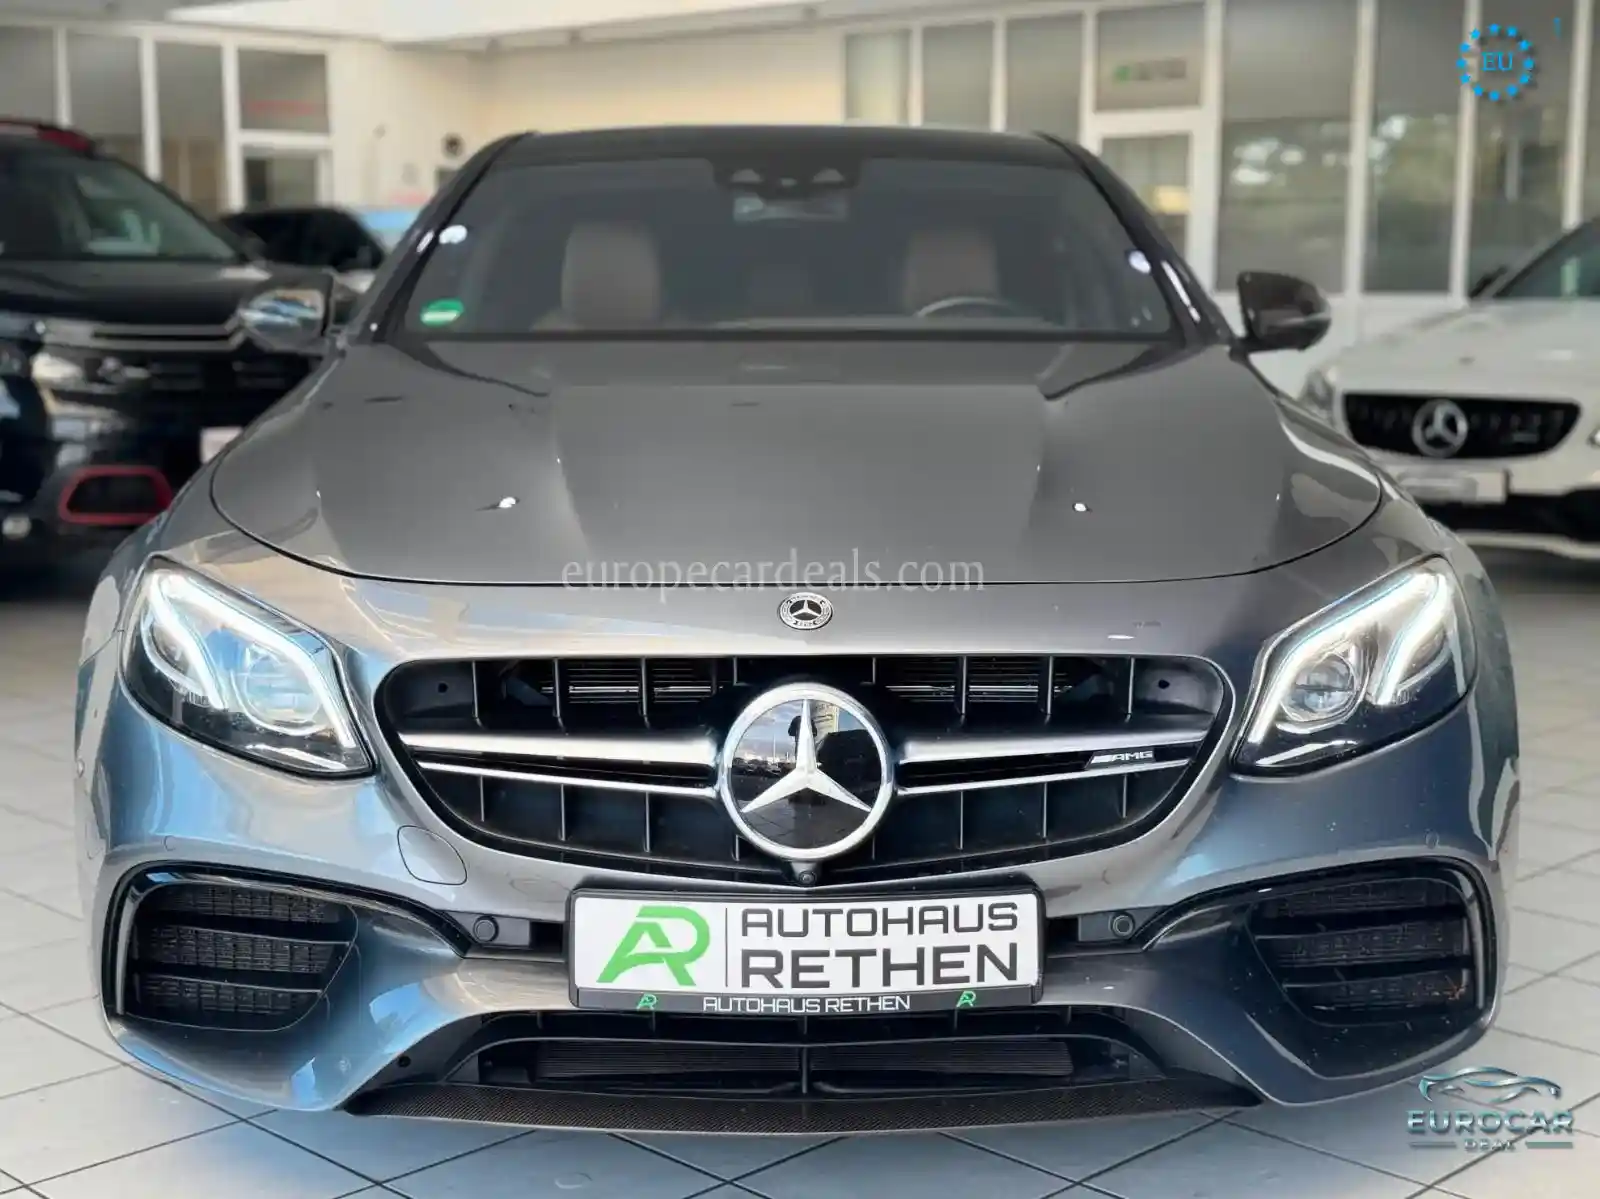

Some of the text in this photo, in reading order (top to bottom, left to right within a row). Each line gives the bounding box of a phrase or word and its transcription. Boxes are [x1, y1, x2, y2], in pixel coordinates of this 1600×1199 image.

[1111, 750, 1154, 762] AMG
[740, 902, 1019, 938] AUTOHAUS
[740, 942, 1019, 989] RETHEN
[702, 994, 911, 1014] AUTOHAUS RETHEN
